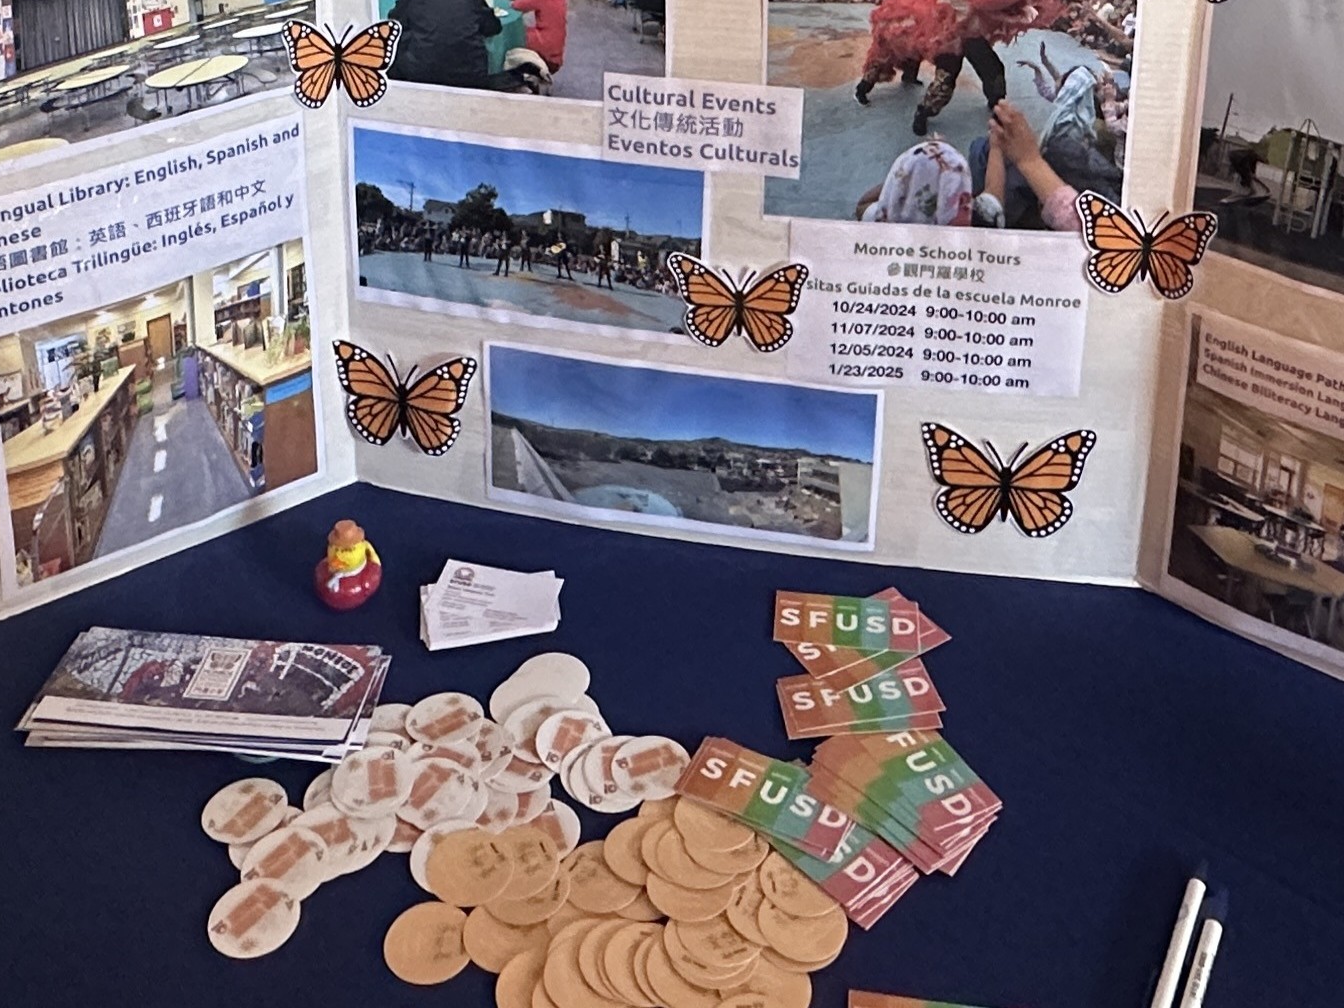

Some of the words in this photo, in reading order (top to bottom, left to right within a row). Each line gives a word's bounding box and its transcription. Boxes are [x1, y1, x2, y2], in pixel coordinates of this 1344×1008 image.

[608, 85, 695, 108] Cultural
[702, 93, 776, 115] Events
[608, 107, 744, 138] 文化傳統活動
[58, 176, 131, 206] Library:
[135, 157, 203, 184] English,
[206, 135, 268, 165] Spanish
[273, 123, 300, 144] and
[608, 134, 693, 158] Eventos
[699, 143, 799, 168] Culturals
[72, 239, 158, 274] Trilingüe:
[161, 221, 216, 249] Inglés,
[220, 199, 282, 229] Español
[284, 193, 294, 209] y
[853, 243, 915, 258] Monroe
[919, 246, 972, 262] School
[978, 251, 1021, 266] Tours
[806, 278, 842, 293] sitas
[913, 284, 932, 298] de
[937, 286, 951, 299] la
[955, 289, 1016, 306] escuela
[1019, 294, 1081, 309] Monroe
[832, 301, 916, 317] 10/24/2024
[925, 306, 1007, 325] 9:00-10:00
[1011, 315, 1036, 326] am
[831, 322, 915, 338] 11/07/2024
[924, 328, 1005, 346] 9:00-10:00
[1009, 336, 1034, 347] am
[829, 343, 914, 359] 12/05/2024
[922, 348, 1003, 367] 9:00-10:00
[1007, 357, 1032, 368] am
[1205, 333, 1249, 357] English
[1251, 349, 1313, 380] Language
[828, 363, 904, 379] 1/23/2025
[920, 370, 1001, 388] 9:00-10:00
[1005, 378, 1030, 389] am
[1202, 363, 1248, 391] Chinese
[1251, 382, 1312, 415] Biliteracy
[1204, 348, 1247, 373] Spanish
[1250, 363, 1314, 398] Immersion
[780, 607, 915, 635] SFUSD
[791, 676, 930, 711] SFUSD
[886, 731, 973, 816] FUSD
[699, 757, 847, 828] SFUSD
